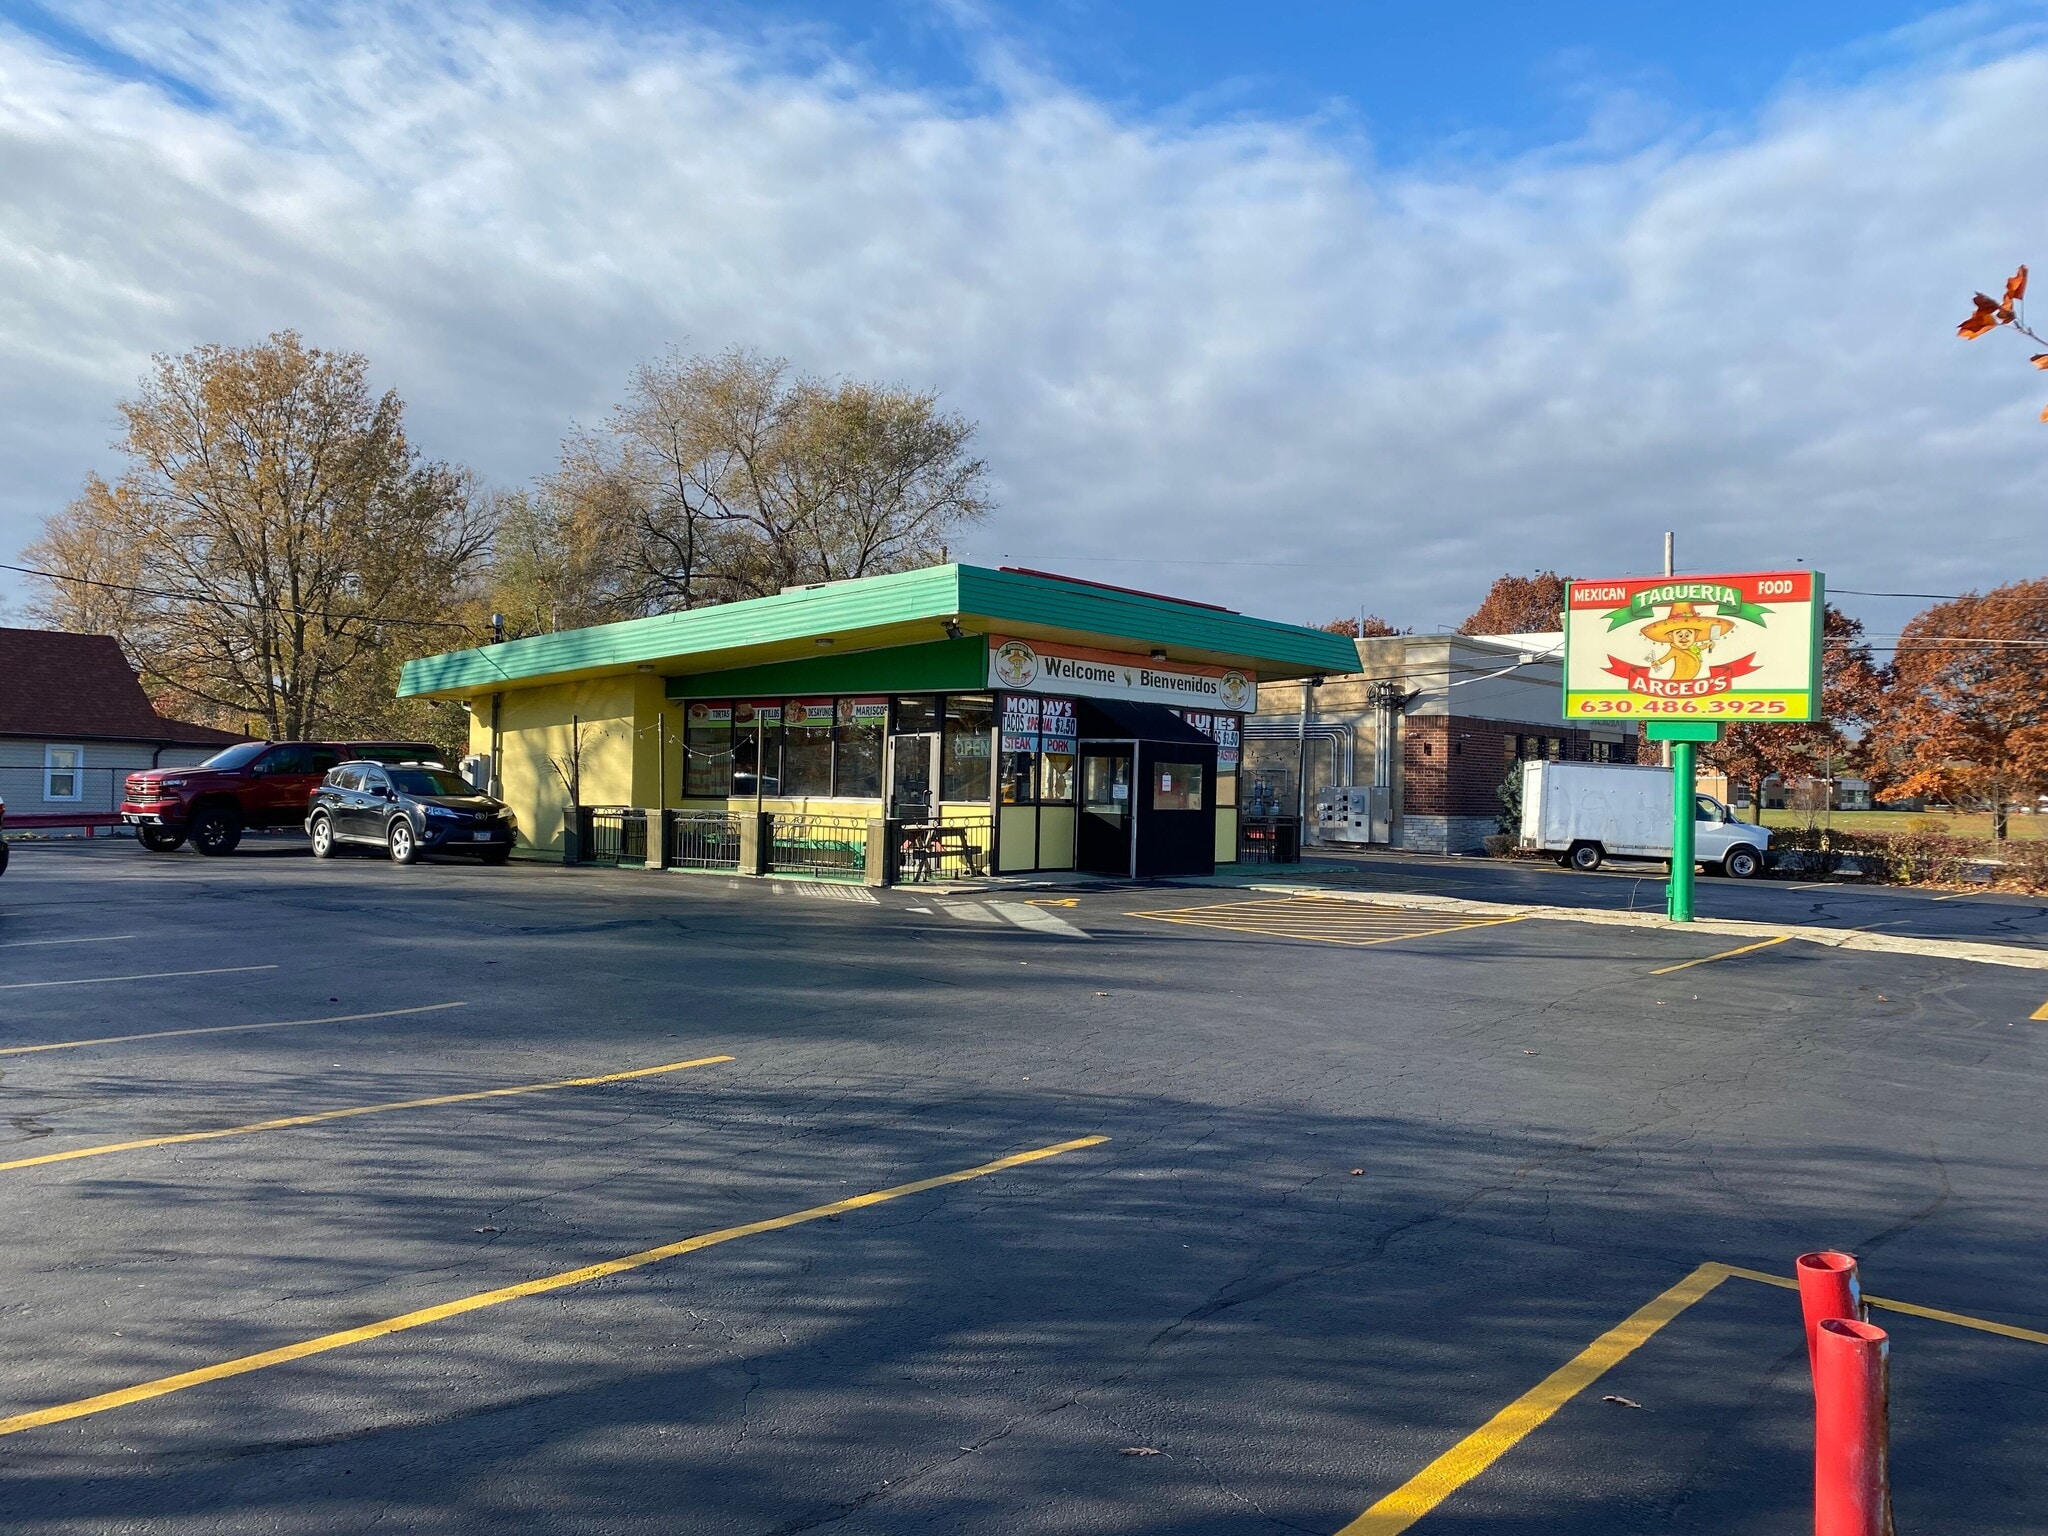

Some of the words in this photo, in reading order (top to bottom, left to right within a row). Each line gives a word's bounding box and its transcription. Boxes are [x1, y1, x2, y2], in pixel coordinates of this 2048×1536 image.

[1574, 587, 1626, 602] MEXICAN
[1757, 579, 1793, 595] FOOD
[1636, 584, 1737, 608] TAQUERIA
[1044, 657, 1116, 683] Welcome
[1140, 669, 1217, 695] Bienvenidos
[1632, 675, 1728, 696] ARCEO'S
[712, 709, 730, 719] TORTAS
[1580, 699, 1787, 714] 630.486.3925
[1003, 713, 1024, 732] TACOS
[1055, 717, 1076, 735] $2.50
[954, 739, 990, 756] OPEN
[1005, 737, 1031, 750] STEAK
[1047, 739, 1069, 752] PORK
